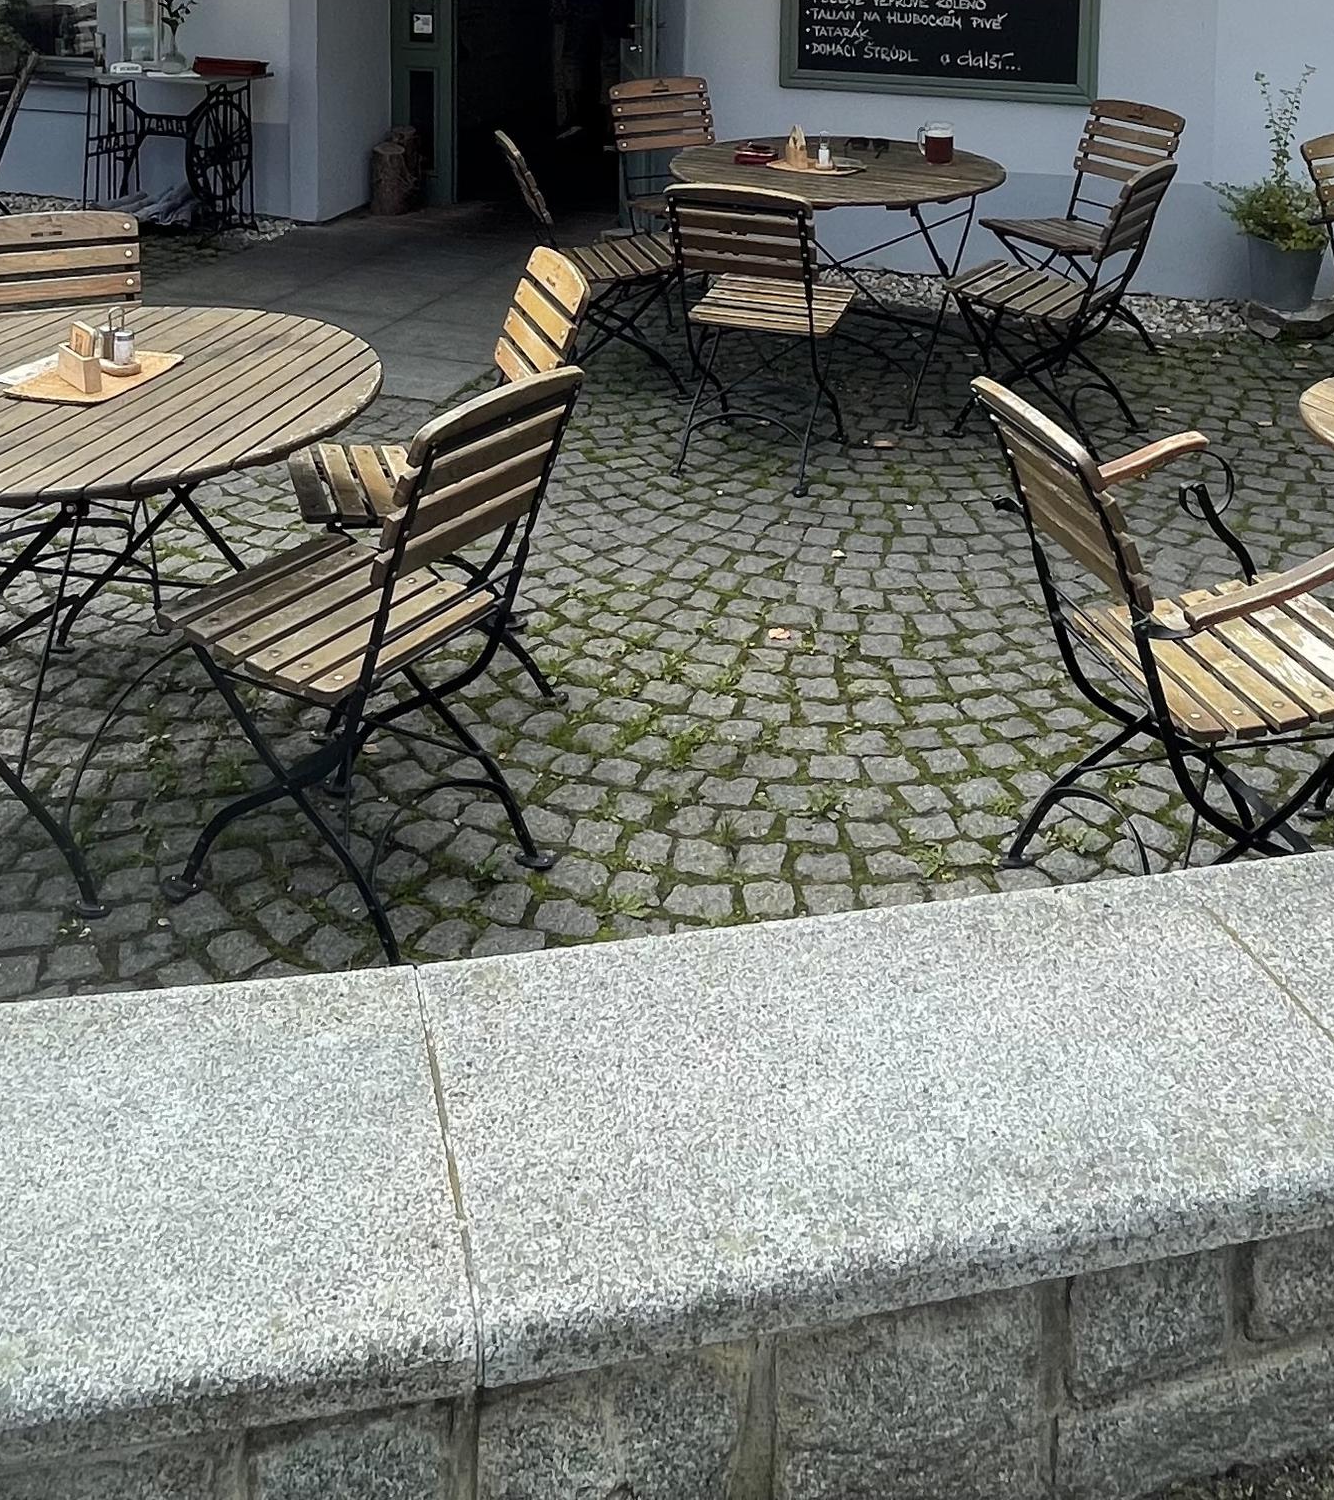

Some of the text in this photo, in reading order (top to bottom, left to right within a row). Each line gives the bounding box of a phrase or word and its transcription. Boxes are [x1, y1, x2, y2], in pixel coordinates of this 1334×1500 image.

[812, 21, 871, 39] TATARÁK
[863, 11, 881, 22] NA
[886, 10, 962, 30] HLUBOCKÉM
[970, 13, 1008, 29] PIVĚ
[811, 38, 862, 57] DOMÁCÍ
[940, 54, 951, 65] a
